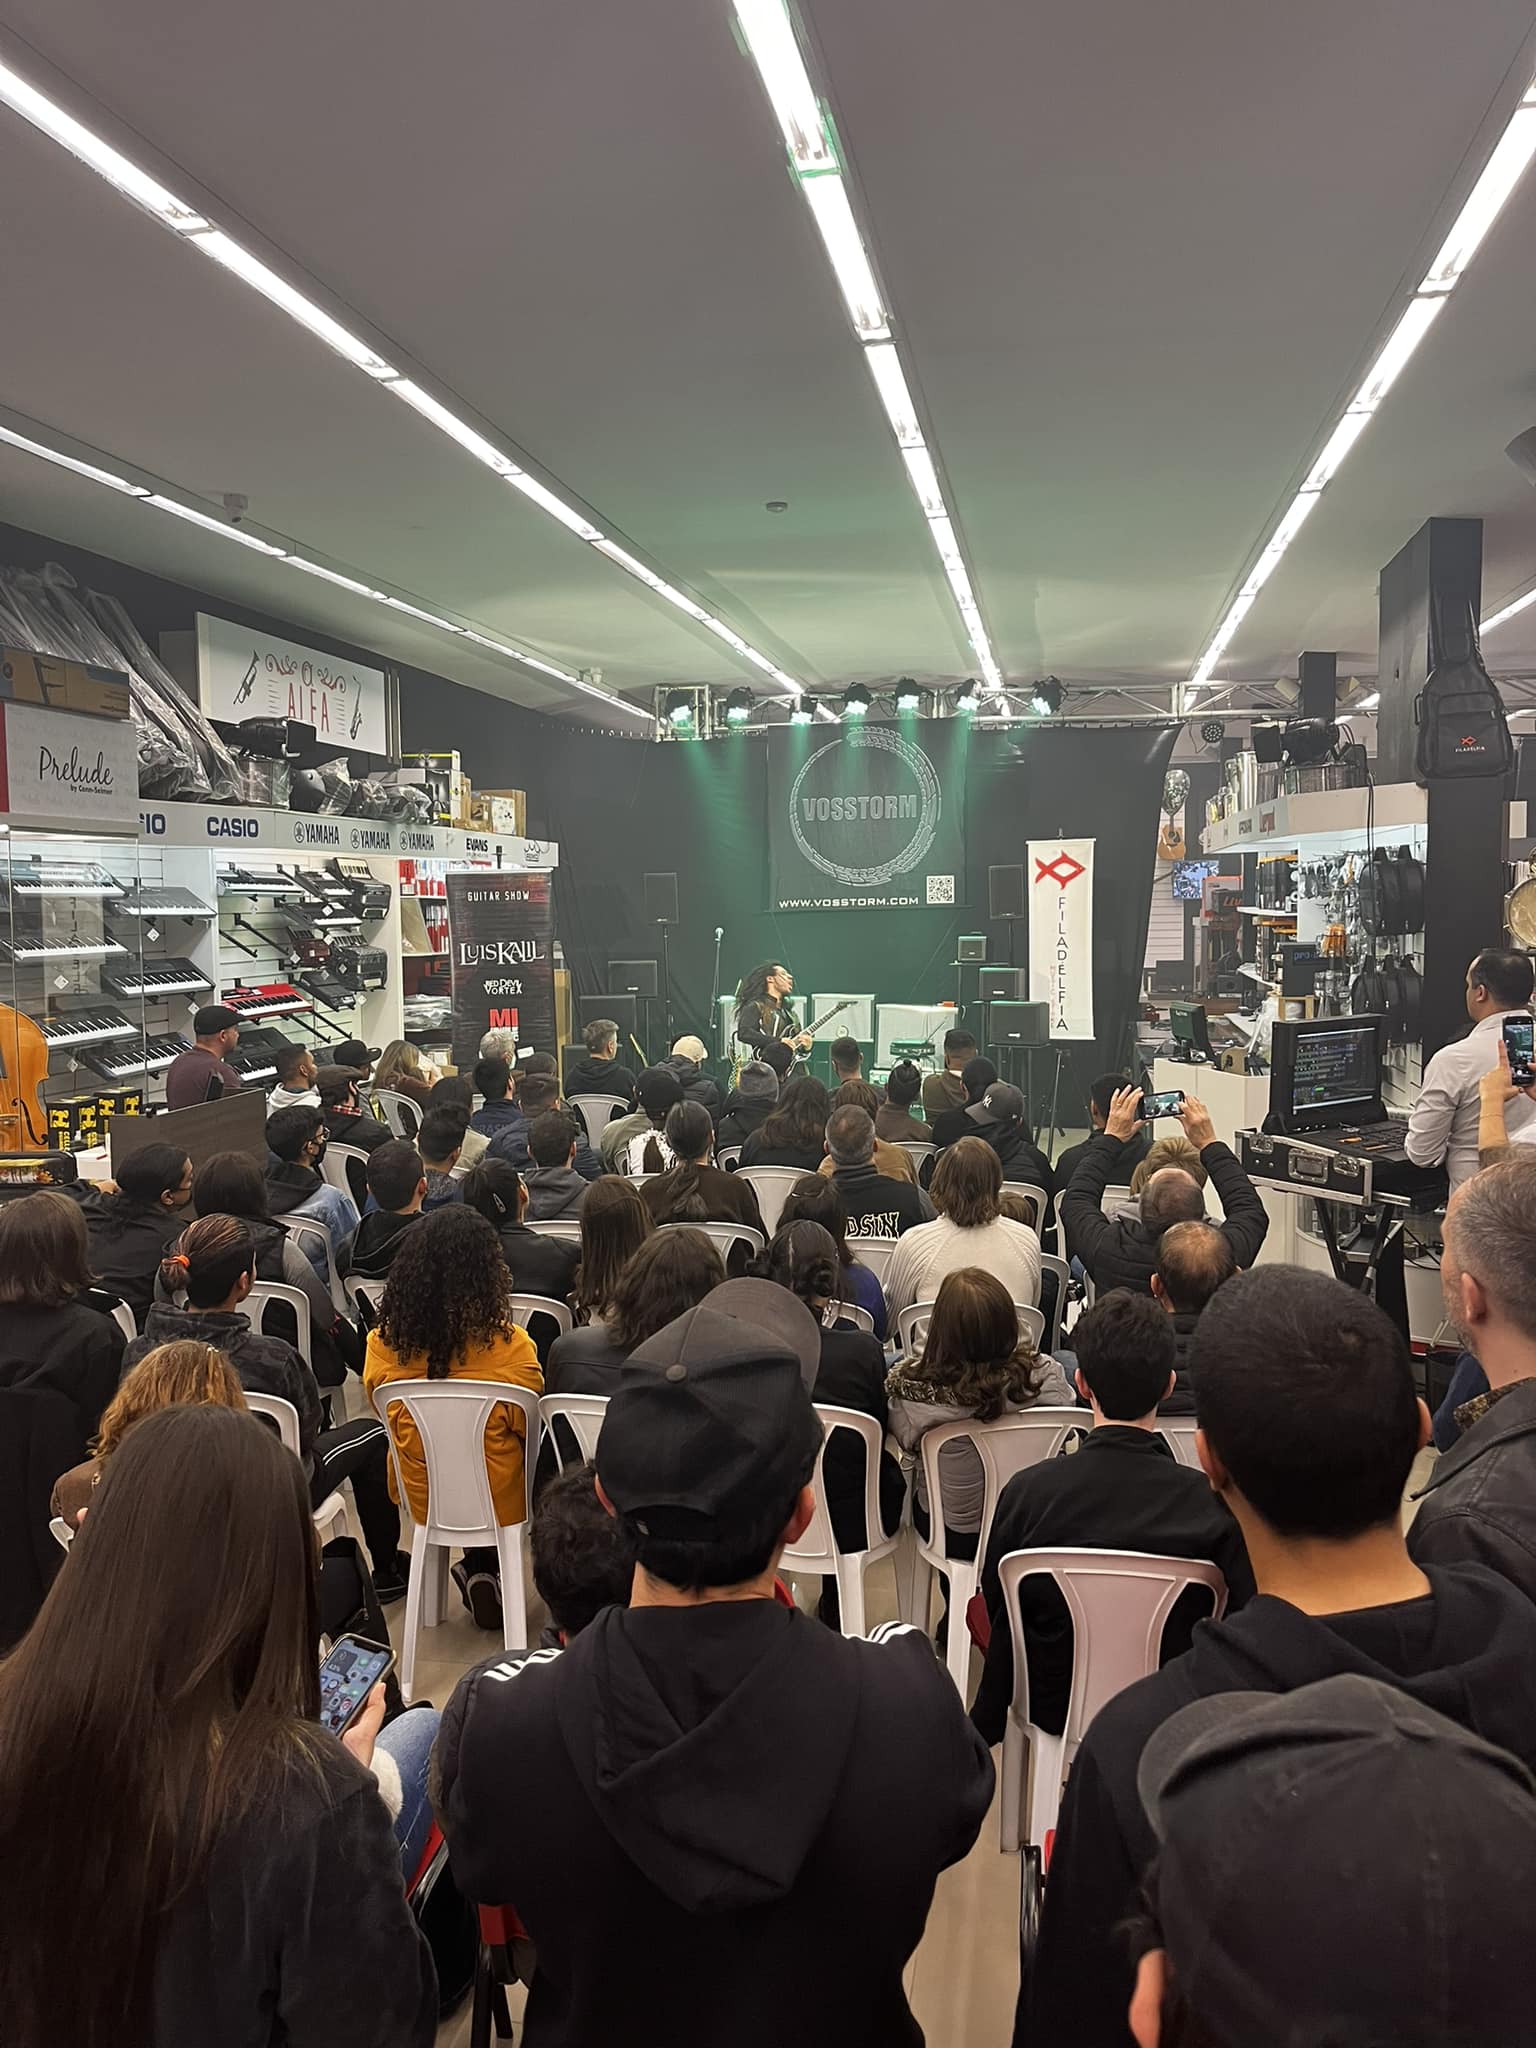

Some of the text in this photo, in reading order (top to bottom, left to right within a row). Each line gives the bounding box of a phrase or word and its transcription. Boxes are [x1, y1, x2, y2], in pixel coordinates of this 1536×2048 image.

[39, 746, 114, 786] Prelude
[802, 794, 918, 822] VOSSTORM
[206, 816, 259, 838] CASIO
[305, 823, 340, 845] YAMAHA
[360, 830, 391, 850] YAMAHA
[409, 831, 435, 851] YAMAHA
[466, 837, 489, 852] EVANS
[467, 890, 529, 901] GUITAR SHOW
[779, 896, 919, 909] WWW.VOSSTORM.COM
[482, 982, 523, 995] VORTEX
[489, 1007, 519, 1028] MI
